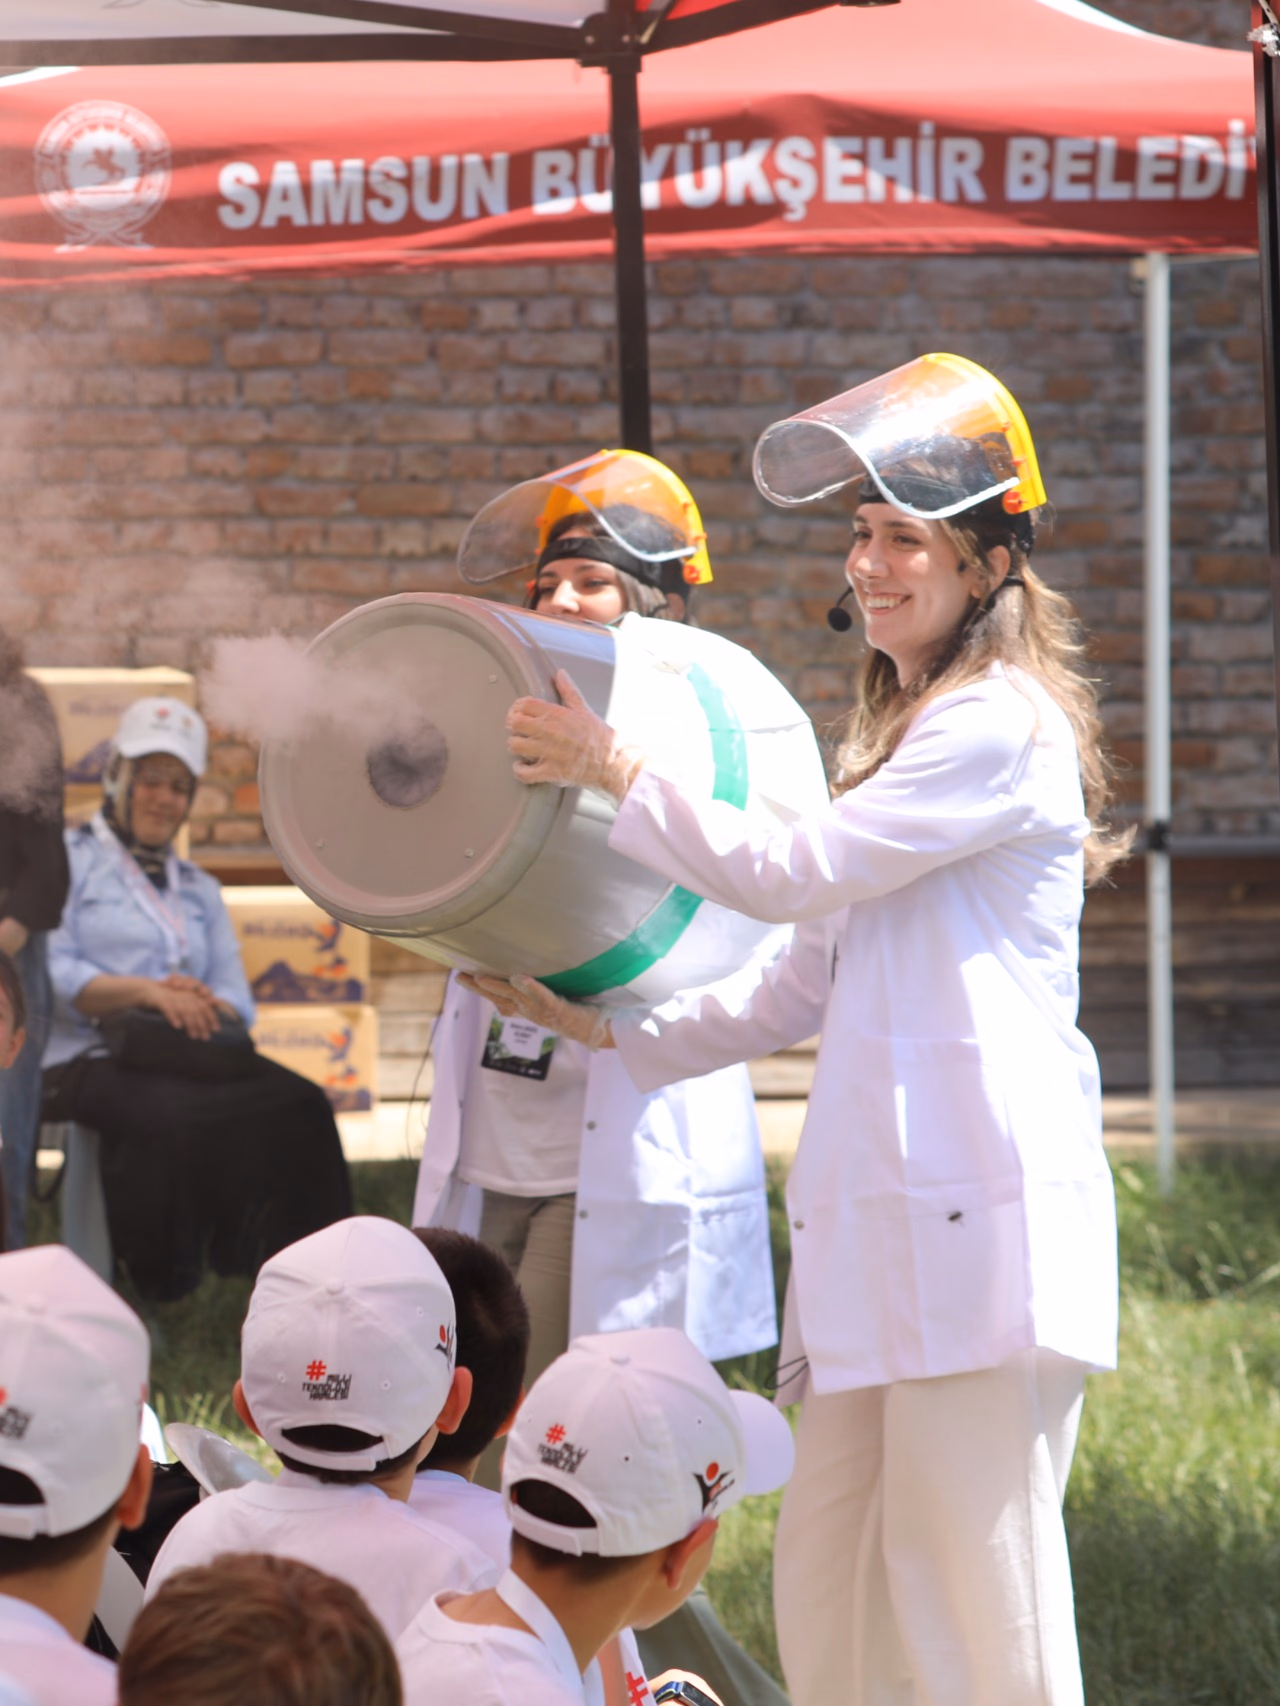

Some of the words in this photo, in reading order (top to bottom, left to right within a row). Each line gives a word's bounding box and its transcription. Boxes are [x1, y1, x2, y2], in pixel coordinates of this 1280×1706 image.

[217, 153, 509, 229] SAMSUN
[532, 128, 986, 222] BÜYÜKŞEHİR
[1005, 119, 1256, 200] BELEDİ
